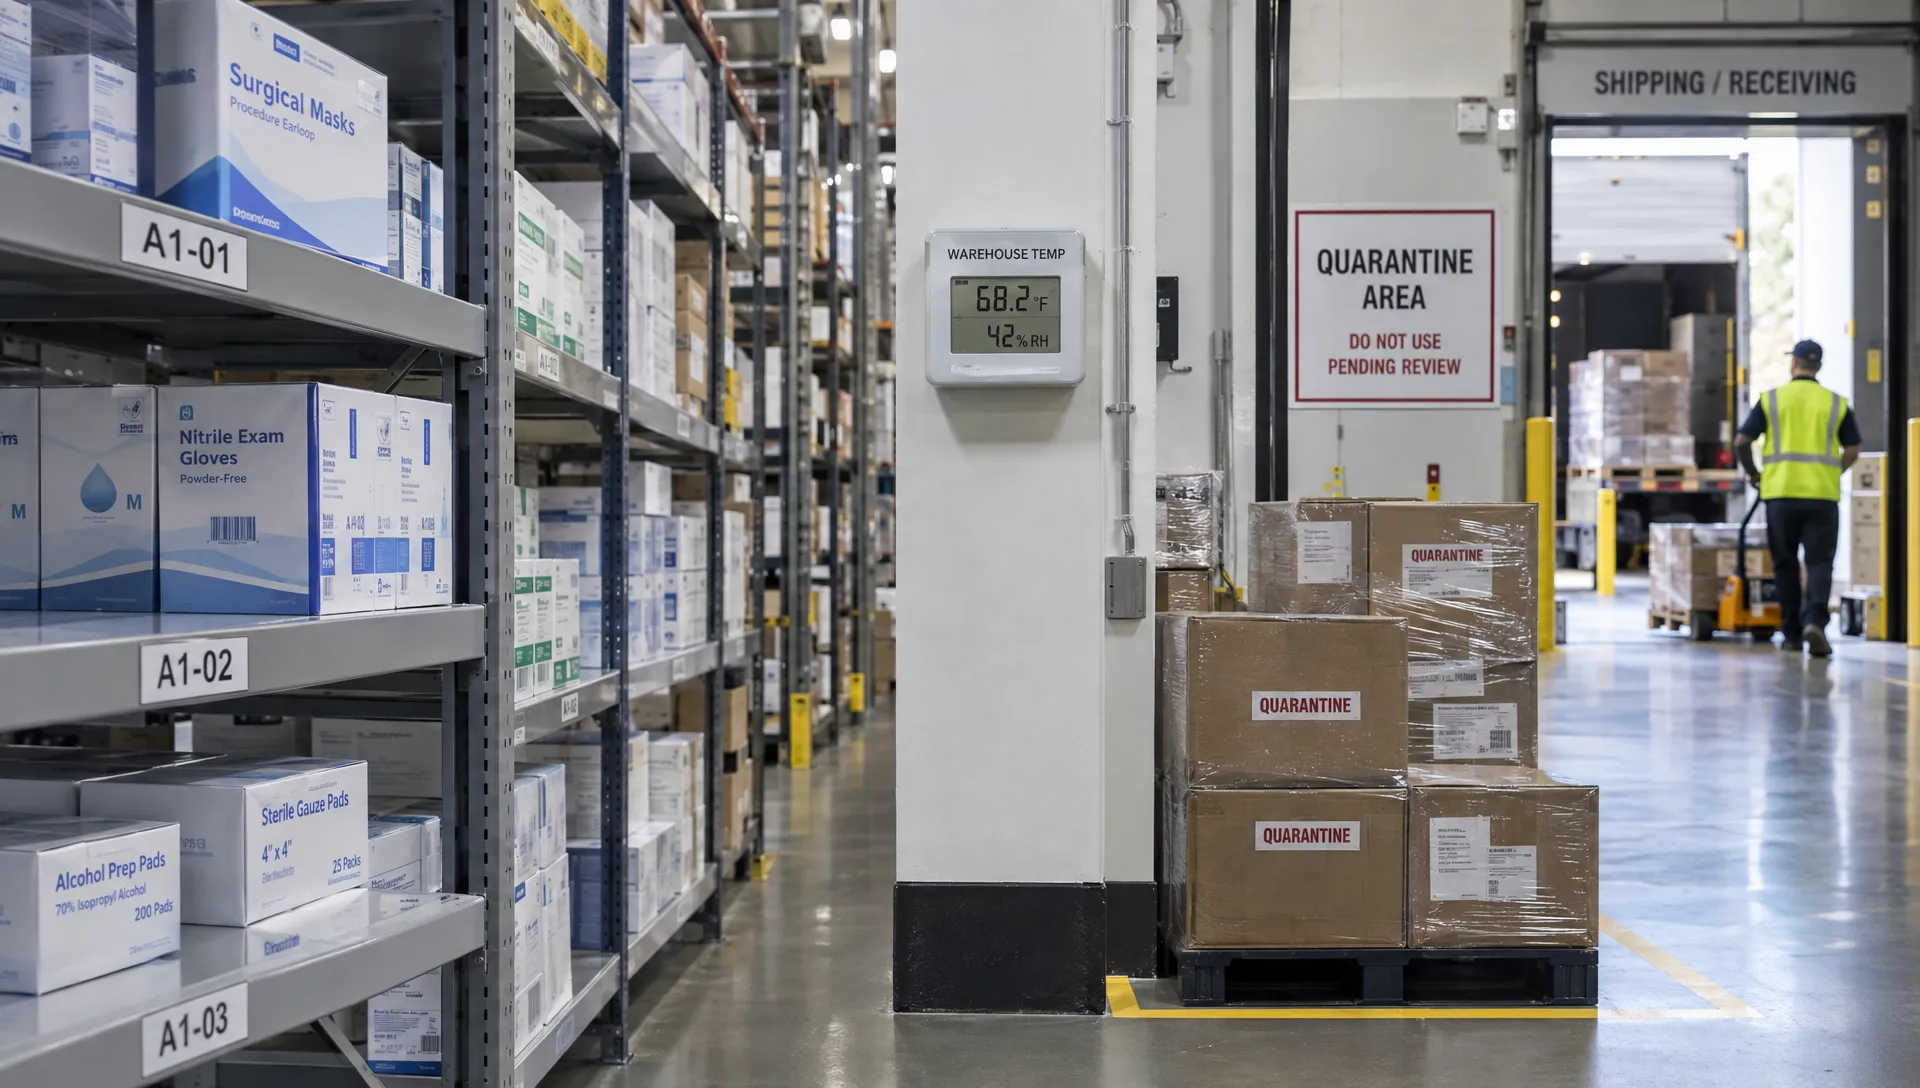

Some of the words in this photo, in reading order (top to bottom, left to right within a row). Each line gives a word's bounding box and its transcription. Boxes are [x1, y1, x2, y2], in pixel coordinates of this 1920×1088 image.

[1595, 70, 1705, 95] SHIPPING
[1711, 70, 1723, 96] /
[1729, 70, 1856, 95] RECEIVING
[230, 62, 304, 115] Surgical
[310, 97, 355, 136] Masks
[230, 96, 280, 127] Procedure
[283, 118, 315, 142] Earloop
[143, 222, 228, 274] A1-01
[947, 248, 1029, 260] WAREHOUSE
[1031, 248, 1066, 260] TEMP
[1317, 248, 1473, 275] QUARANTINE
[976, 285, 1030, 312] 68.2
[1362, 285, 1426, 310] AREA
[1349, 333, 1371, 350] DO
[1376, 333, 1407, 350] NOT
[1412, 333, 1441, 350] USE
[1328, 358, 1396, 375] PENDING
[1402, 358, 1462, 375] REVIEW
[180, 428, 233, 445] Nitrile
[238, 428, 284, 444] Exam
[180, 450, 238, 466] Gloves
[180, 473, 247, 484] Powder-Free
[11, 503, 26, 519] M
[126, 493, 142, 510] M
[1411, 549, 1484, 564] QUARANTINE
[157, 648, 233, 690] A1-02
[1259, 697, 1352, 715] QUARANTINE
[262, 802, 294, 827] Sterile
[296, 799, 326, 818] Gauze
[327, 790, 349, 810] Pads
[1263, 827, 1351, 845] QUARANTINE
[274, 847, 280, 861] x
[332, 858, 341, 875] 25
[343, 853, 362, 871] Packs
[55, 863, 105, 892] Alcohol
[108, 861, 136, 880] Prep
[139, 851, 166, 872] Pads
[55, 901, 76, 917] 70%
[78, 890, 117, 911] Isopropyl
[118, 883, 147, 901] Alcohol
[135, 903, 152, 921] 200
[154, 899, 173, 916] Pads
[159, 1001, 229, 1057] A1-03
